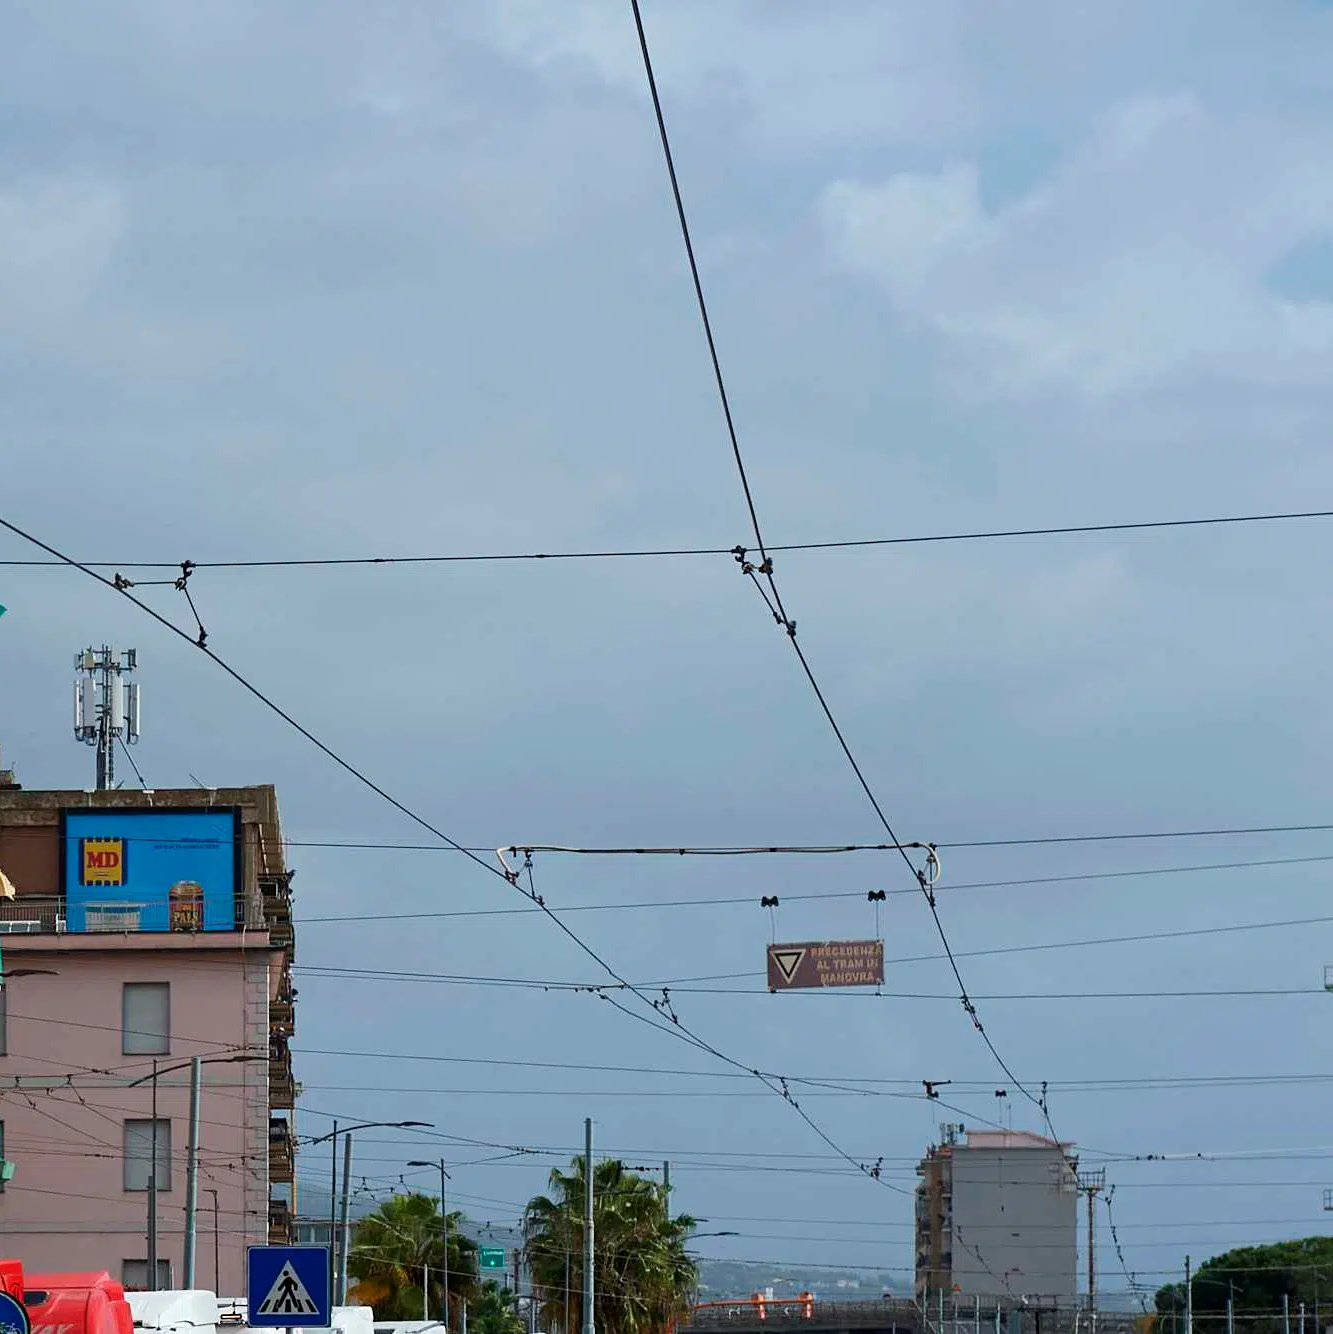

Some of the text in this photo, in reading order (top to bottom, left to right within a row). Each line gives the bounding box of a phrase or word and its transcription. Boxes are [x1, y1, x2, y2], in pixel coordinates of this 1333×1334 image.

[86, 851, 119, 868] MD
[811, 945, 882, 957] PRECEDENZA
[817, 960, 830, 970] AL
[835, 959, 861, 969] TRAM
[821, 971, 874, 982] MANOVRA
